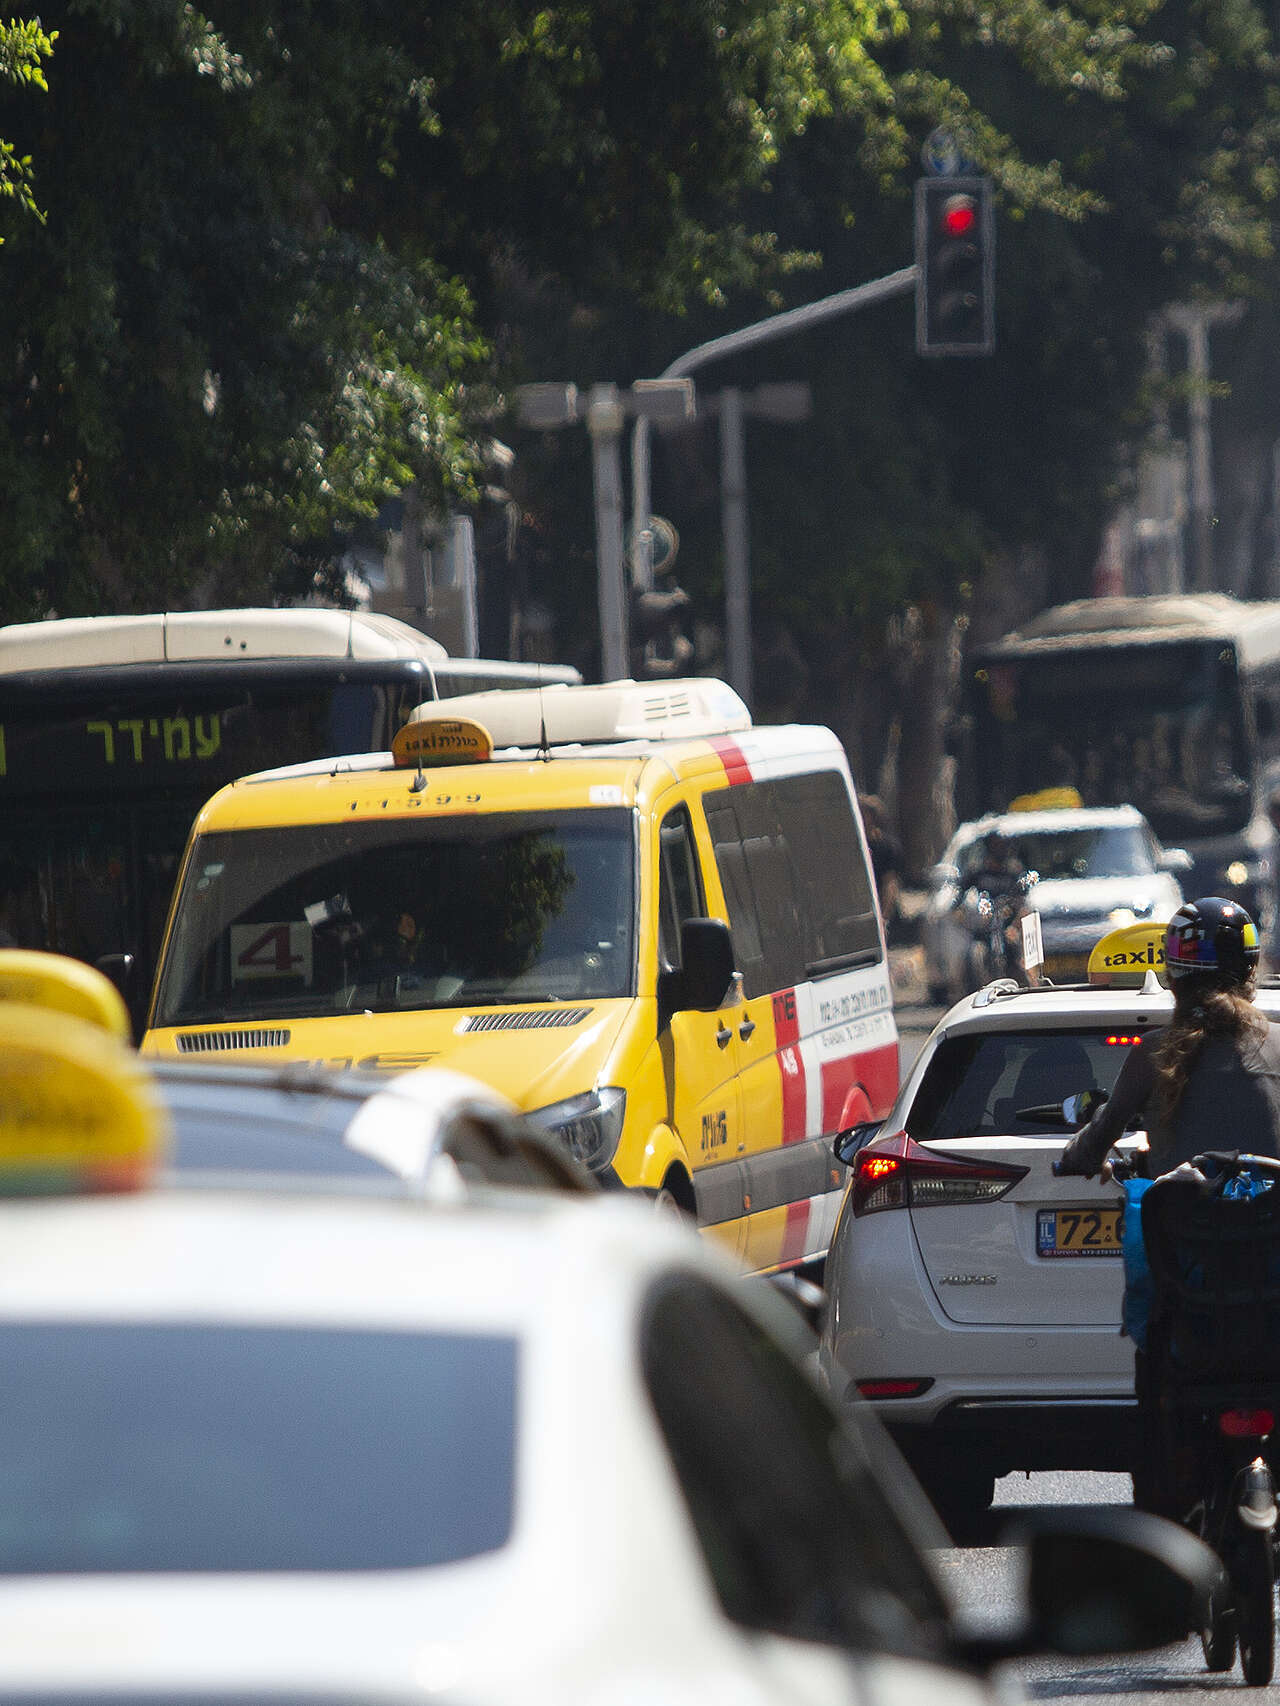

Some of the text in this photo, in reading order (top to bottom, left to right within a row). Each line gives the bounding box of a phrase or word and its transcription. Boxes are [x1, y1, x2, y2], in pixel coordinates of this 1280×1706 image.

[86, 713, 221, 763] עמידר
[238, 926, 304, 971] 4
[1104, 942, 1154, 967] taxi
[1040, 1223, 1053, 1238] IL
